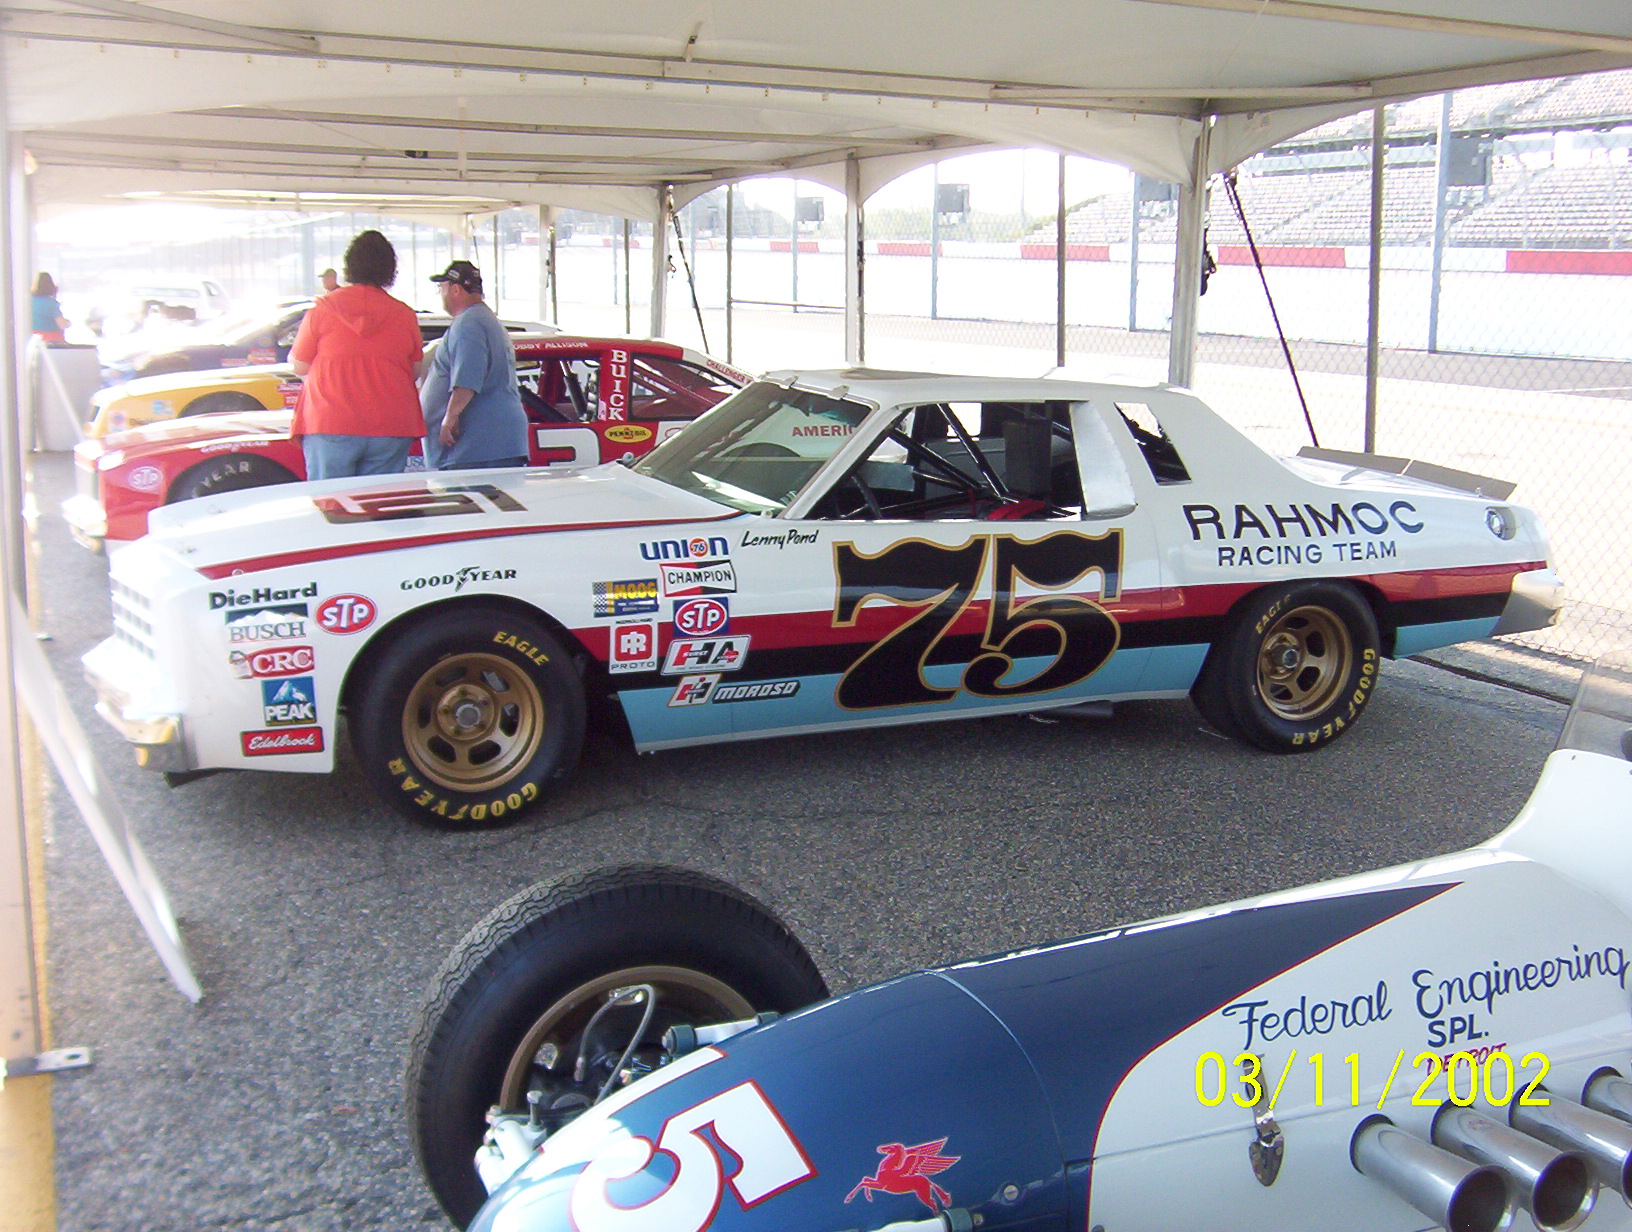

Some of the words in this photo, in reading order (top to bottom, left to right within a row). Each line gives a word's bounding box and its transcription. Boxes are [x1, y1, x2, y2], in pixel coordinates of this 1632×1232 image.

[512, 342, 541, 351] OBBY
[608, 349, 628, 421] BUICK
[132, 468, 159, 487] STP
[1183, 500, 1425, 541] RAHMOC
[741, 530, 784, 549] Lenny
[786, 529, 819, 545] Pond
[1218, 543, 1323, 567] RACING
[1333, 540, 1397, 562] TEAM
[667, 567, 732, 585] CHAMPION
[208, 581, 318, 611] DieHard
[614, 582, 657, 600] MOOG
[321, 597, 371, 629] STP
[682, 602, 721, 629] STP
[831, 527, 1125, 711] 75
[230, 621, 307, 642] BUSCH
[492, 630, 549, 667] EAGLE
[252, 649, 312, 674] CRC
[611, 660, 656, 671] PROTO
[715, 681, 797, 701] MOROSO
[264, 702, 314, 721] PEAK
[248, 733, 316, 750] Edelbrock
[1222, 981, 1393, 1050] Federal
[1411, 944, 1631, 1019] Engineering
[1427, 1014, 1489, 1048] SPL.
